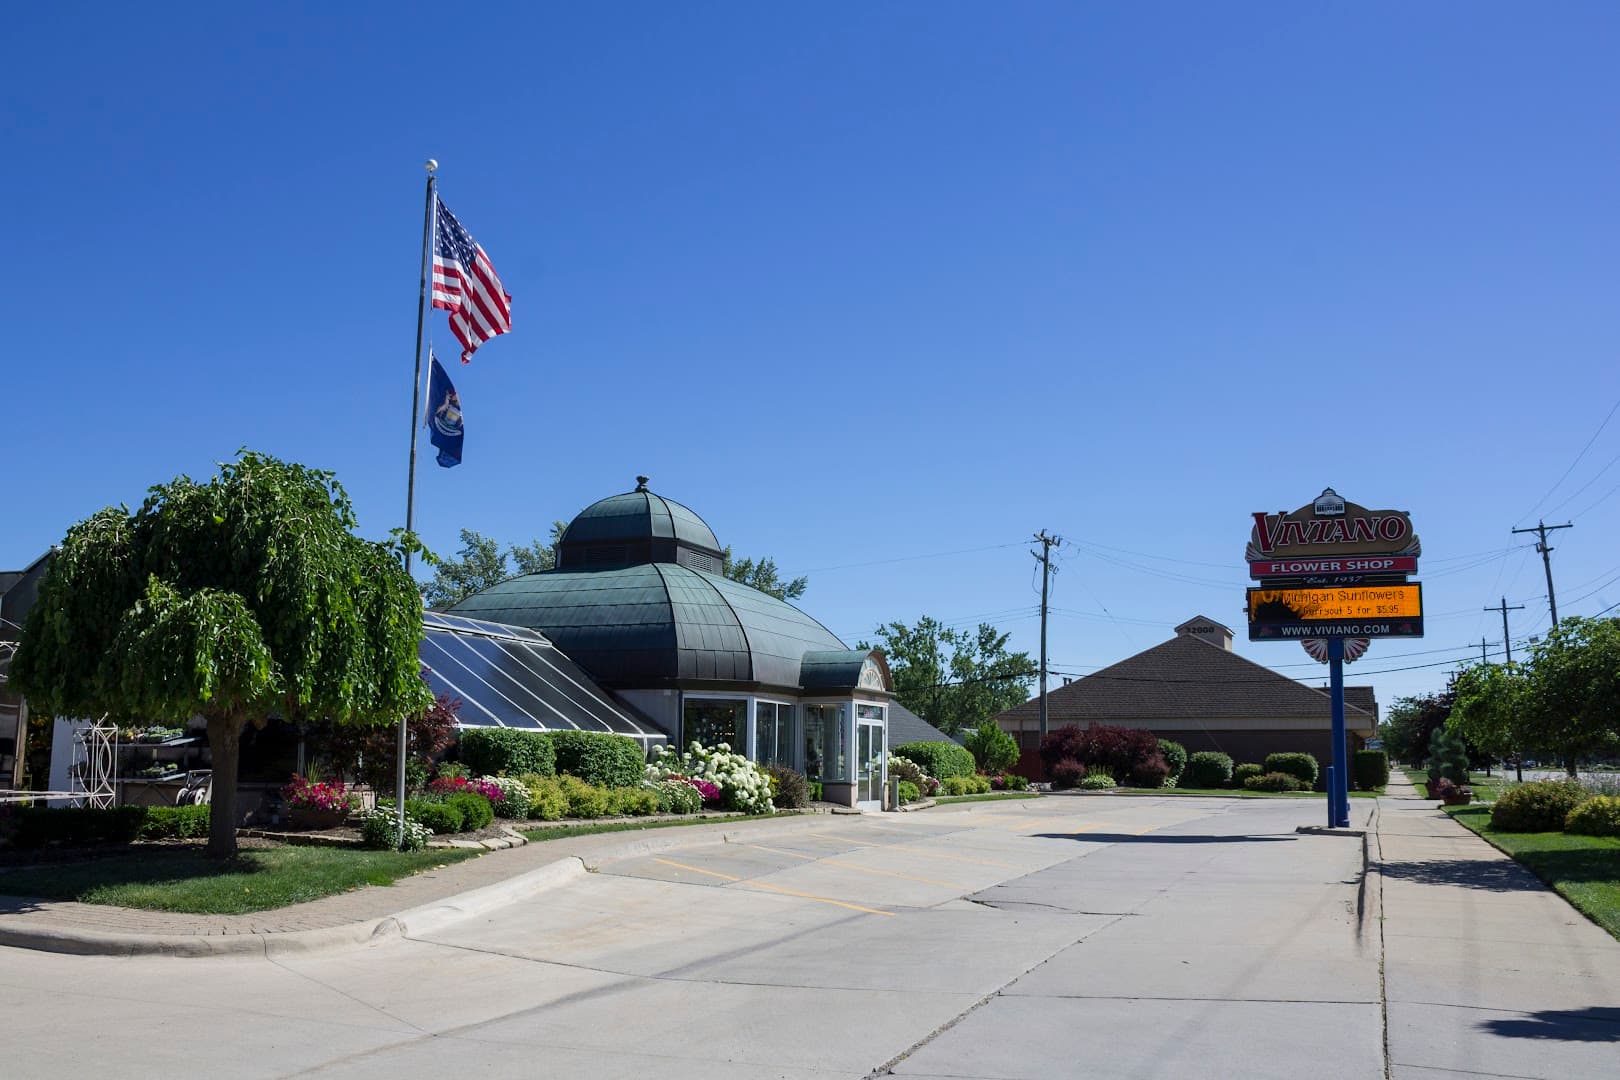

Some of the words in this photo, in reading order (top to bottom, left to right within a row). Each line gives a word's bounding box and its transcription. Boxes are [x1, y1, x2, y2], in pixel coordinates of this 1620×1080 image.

[1271, 562, 1341, 573] FLOWER
[1346, 560, 1394, 571] SHOP
[1338, 589, 1405, 601] Sunflowers
[1347, 605, 1353, 614] 5
[1357, 605, 1370, 614] for
[1282, 624, 1390, 636] WWW.VIVIANO.COM
